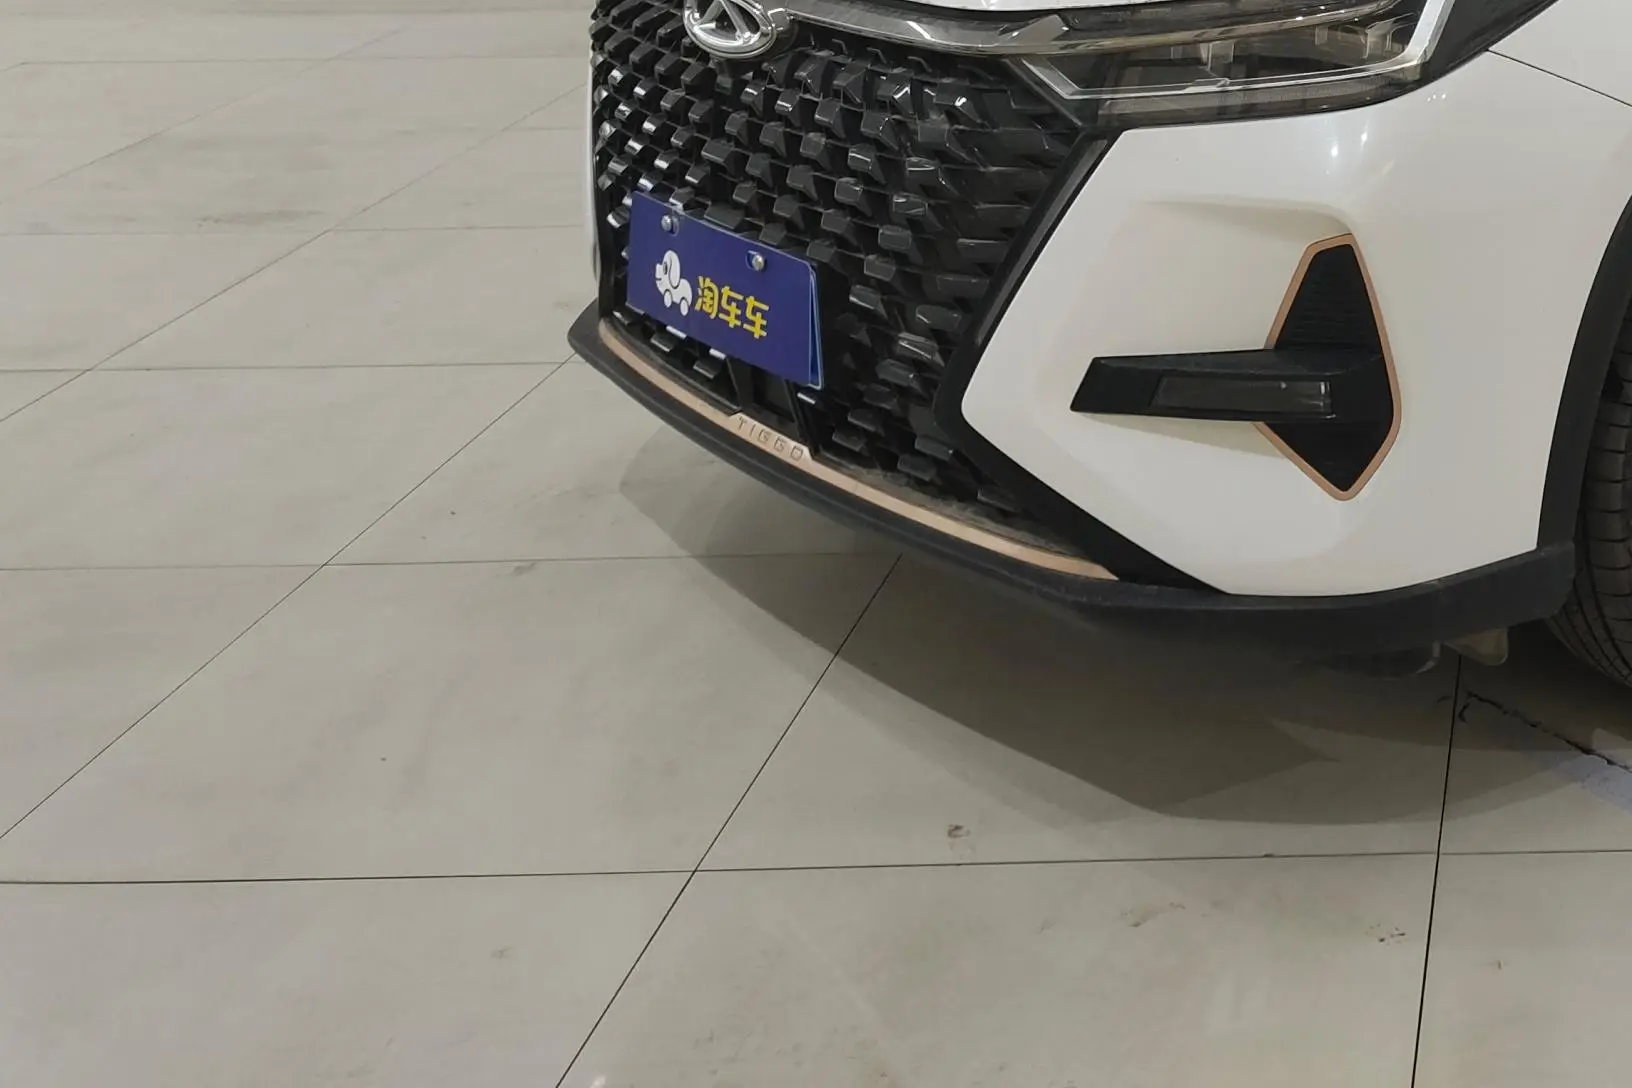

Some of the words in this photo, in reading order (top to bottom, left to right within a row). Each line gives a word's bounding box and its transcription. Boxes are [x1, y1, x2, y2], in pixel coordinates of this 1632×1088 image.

[695, 276, 769, 339] 淘车车
[738, 416, 804, 461] TIGGO
